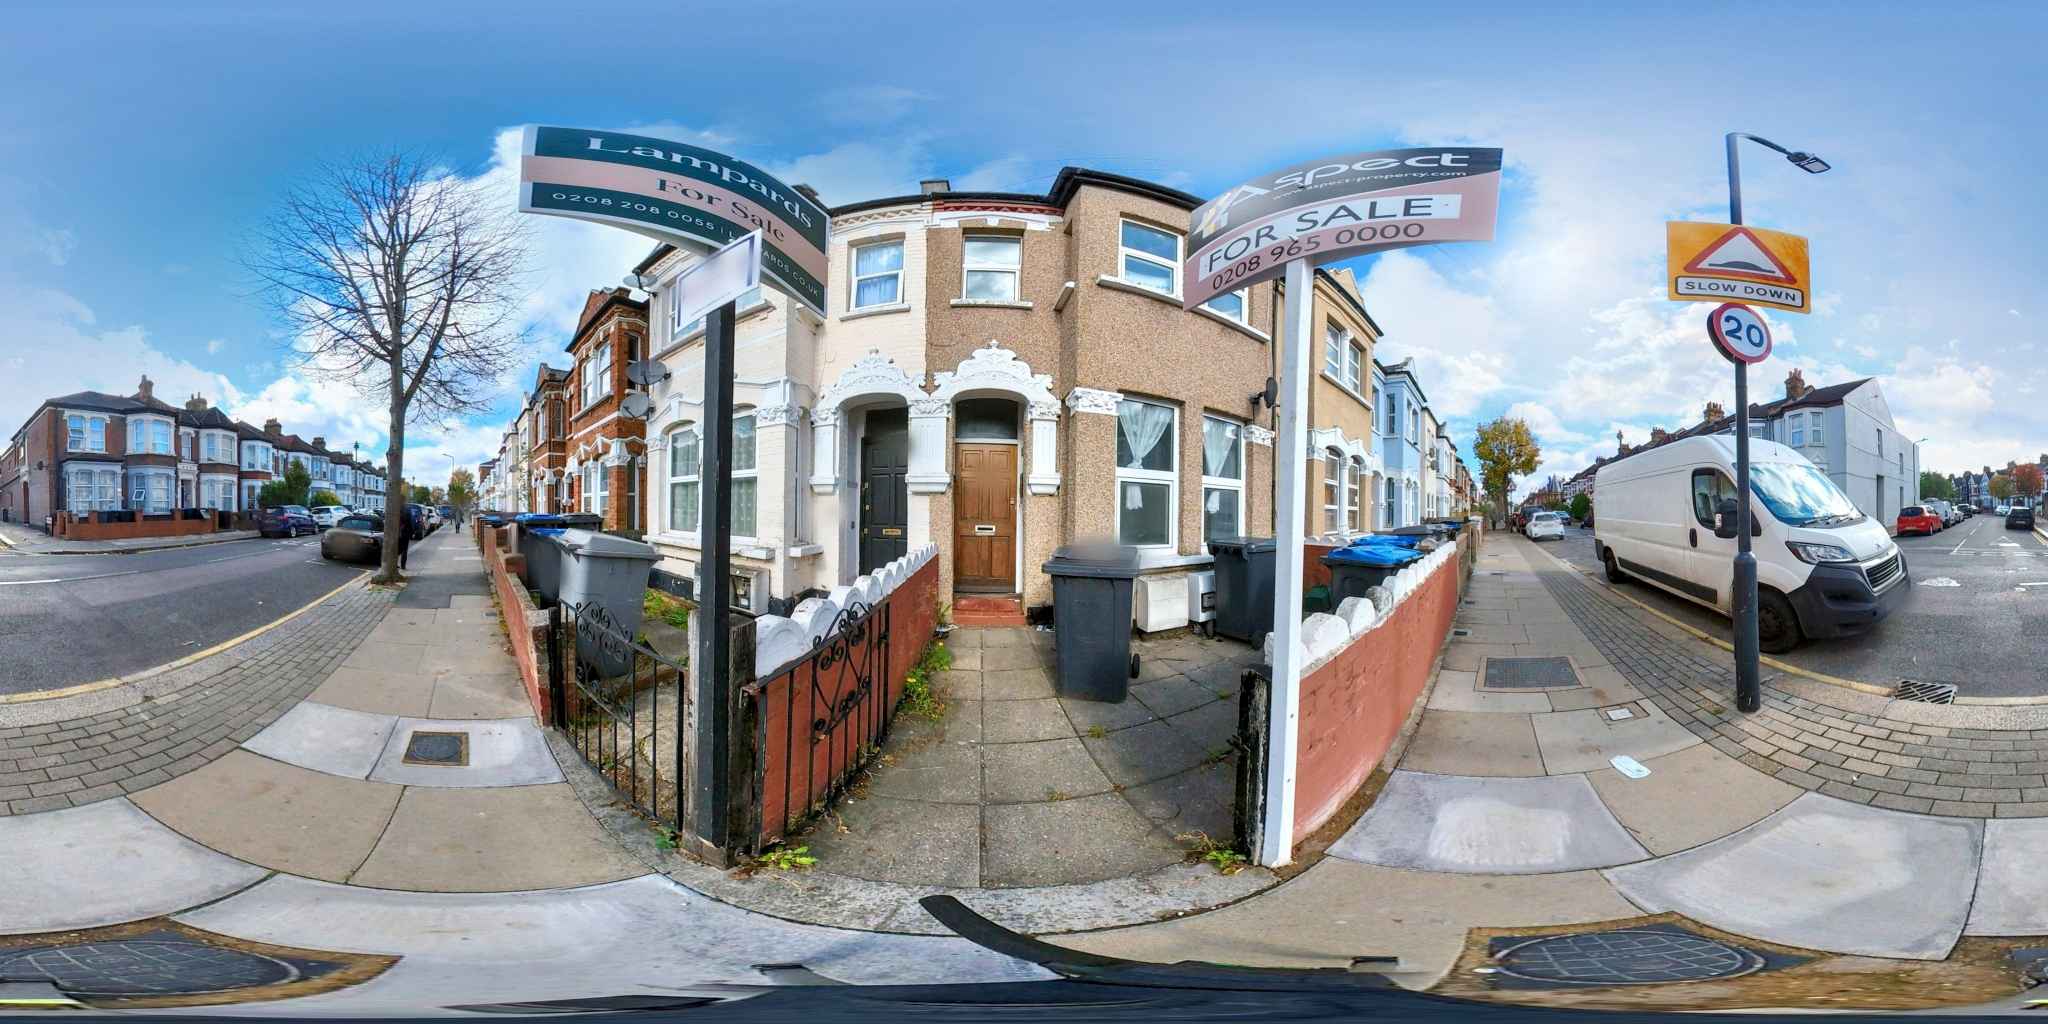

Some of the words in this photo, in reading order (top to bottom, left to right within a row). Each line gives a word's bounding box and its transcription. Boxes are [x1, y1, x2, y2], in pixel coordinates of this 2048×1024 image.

[552, 192, 613, 207] 0208
[621, 200, 660, 215] 208
[667, 210, 715, 231] 0055
[587, 136, 813, 229] Lampards
[655, 178, 724, 206] For
[731, 201, 785, 242] Sale
[1207, 224, 1276, 273] FOR
[1296, 197, 1434, 233] SALE
[1213, 255, 1261, 291] 0208
[1270, 235, 1321, 262] 965
[1335, 222, 1425, 246] 0000
[1685, 281, 1737, 293] SLOW
[1743, 285, 1797, 302] DOWN
[1724, 315, 1765, 348] 20
